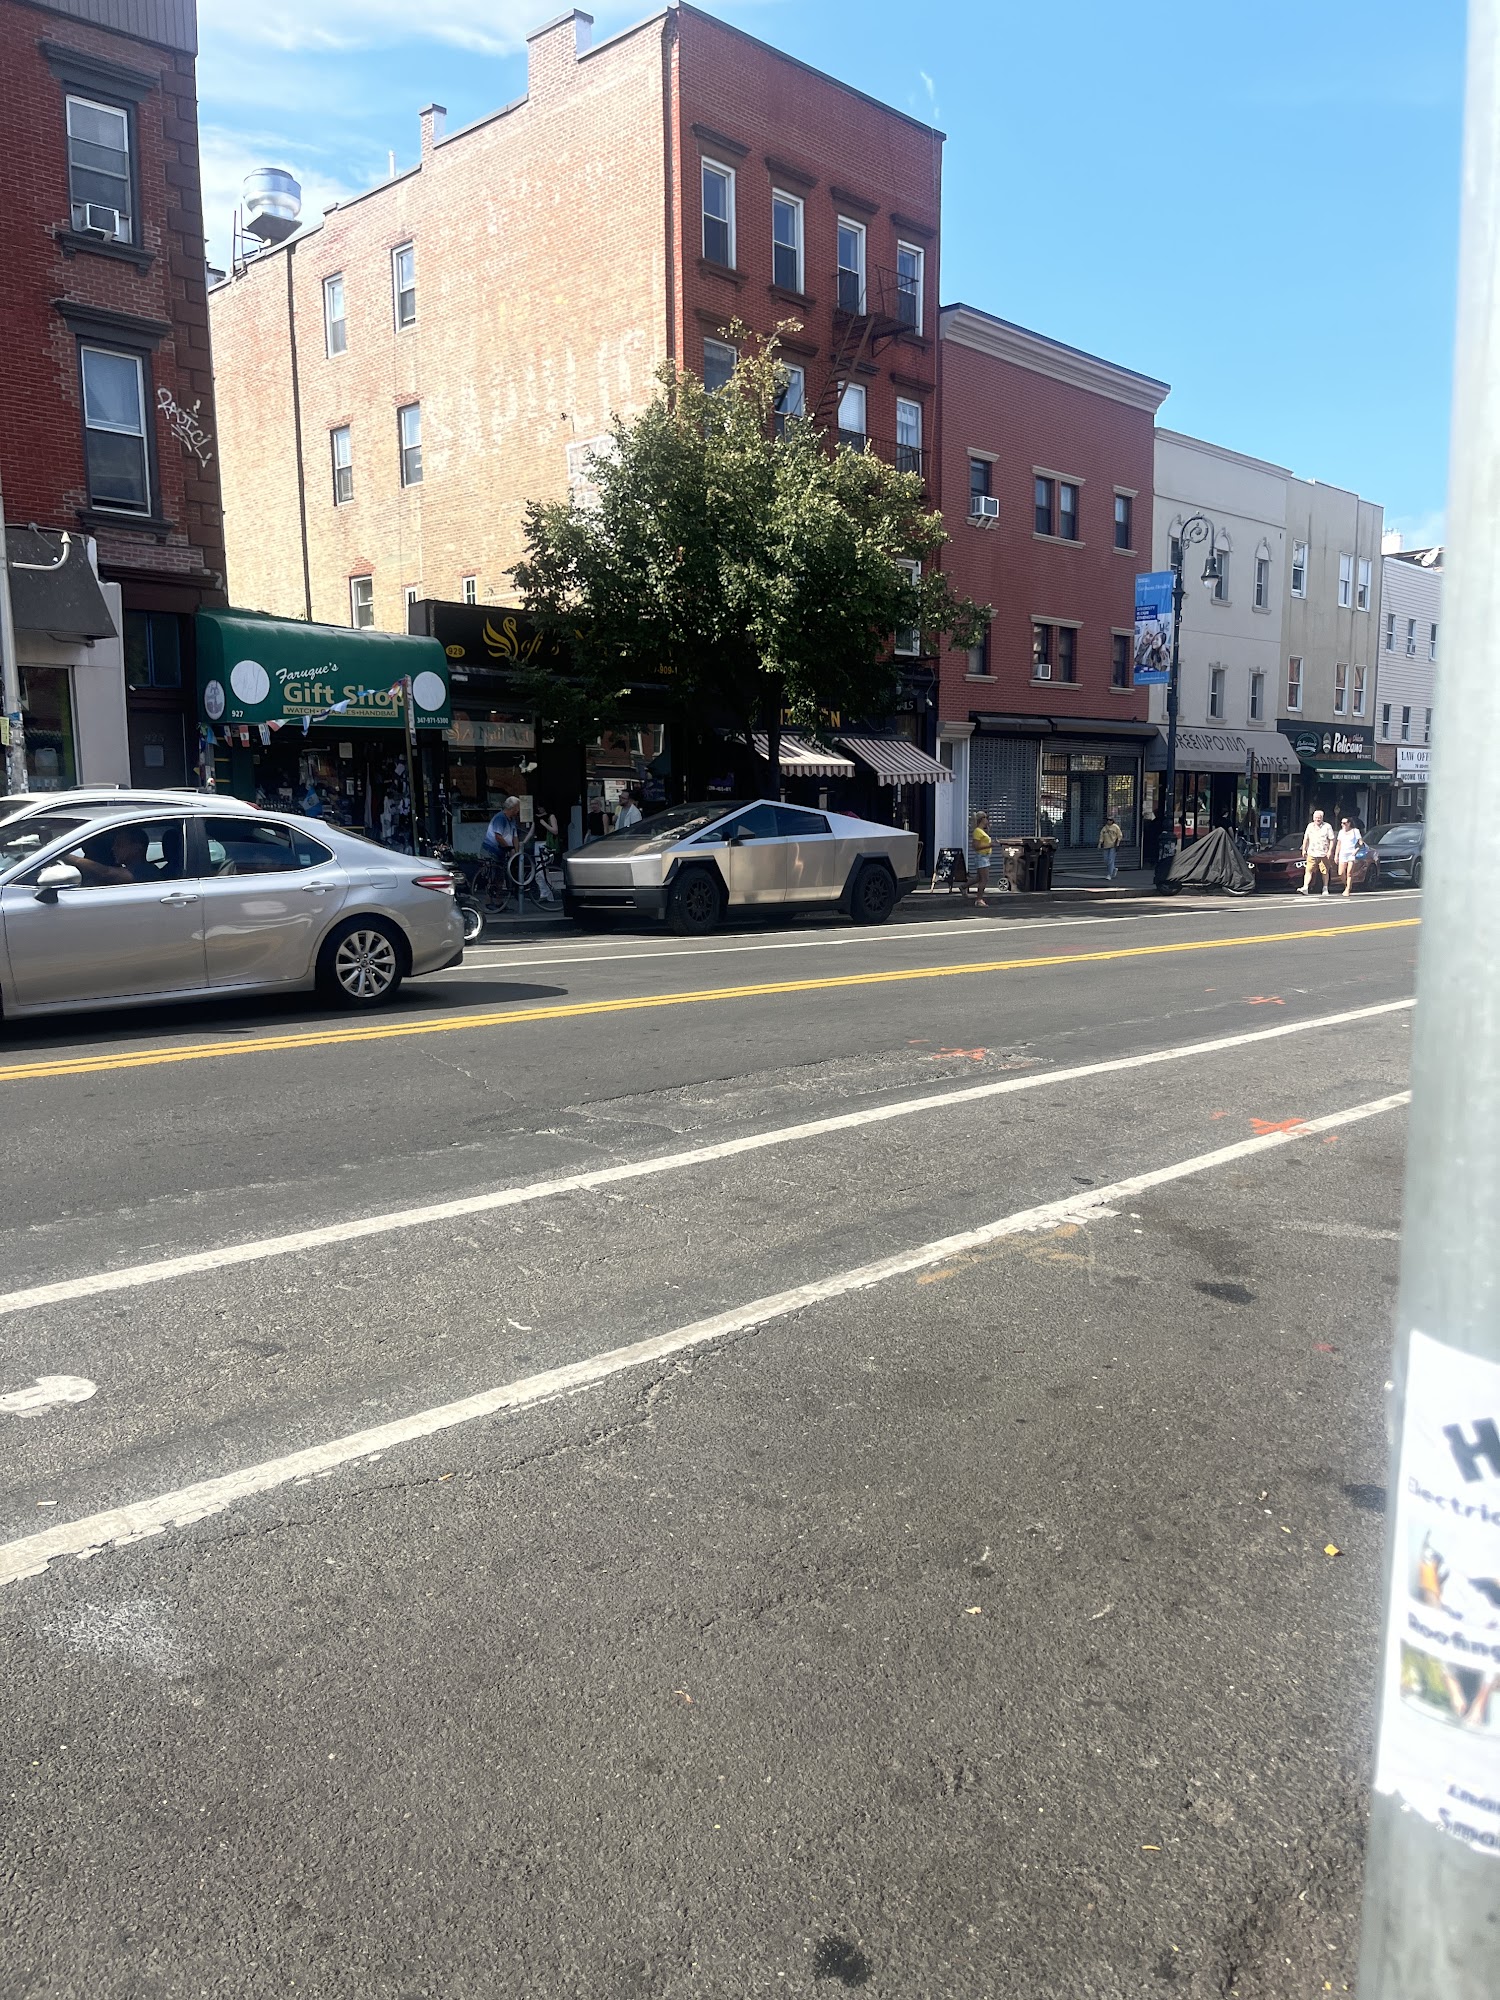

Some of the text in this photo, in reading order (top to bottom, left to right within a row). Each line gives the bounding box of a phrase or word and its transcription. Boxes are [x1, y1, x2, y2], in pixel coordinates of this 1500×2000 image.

[447, 647, 463, 656] 929
[275, 662, 339, 684] Faruque's
[283, 682, 405, 714] Gift Shop
[231, 709, 244, 717] 927
[1167, 733, 1247, 752] REENPOINT
[1332, 732, 1363, 753] Pelicana
[1253, 757, 1288, 772] RAMES
[1401, 751, 1414, 761] LAW
